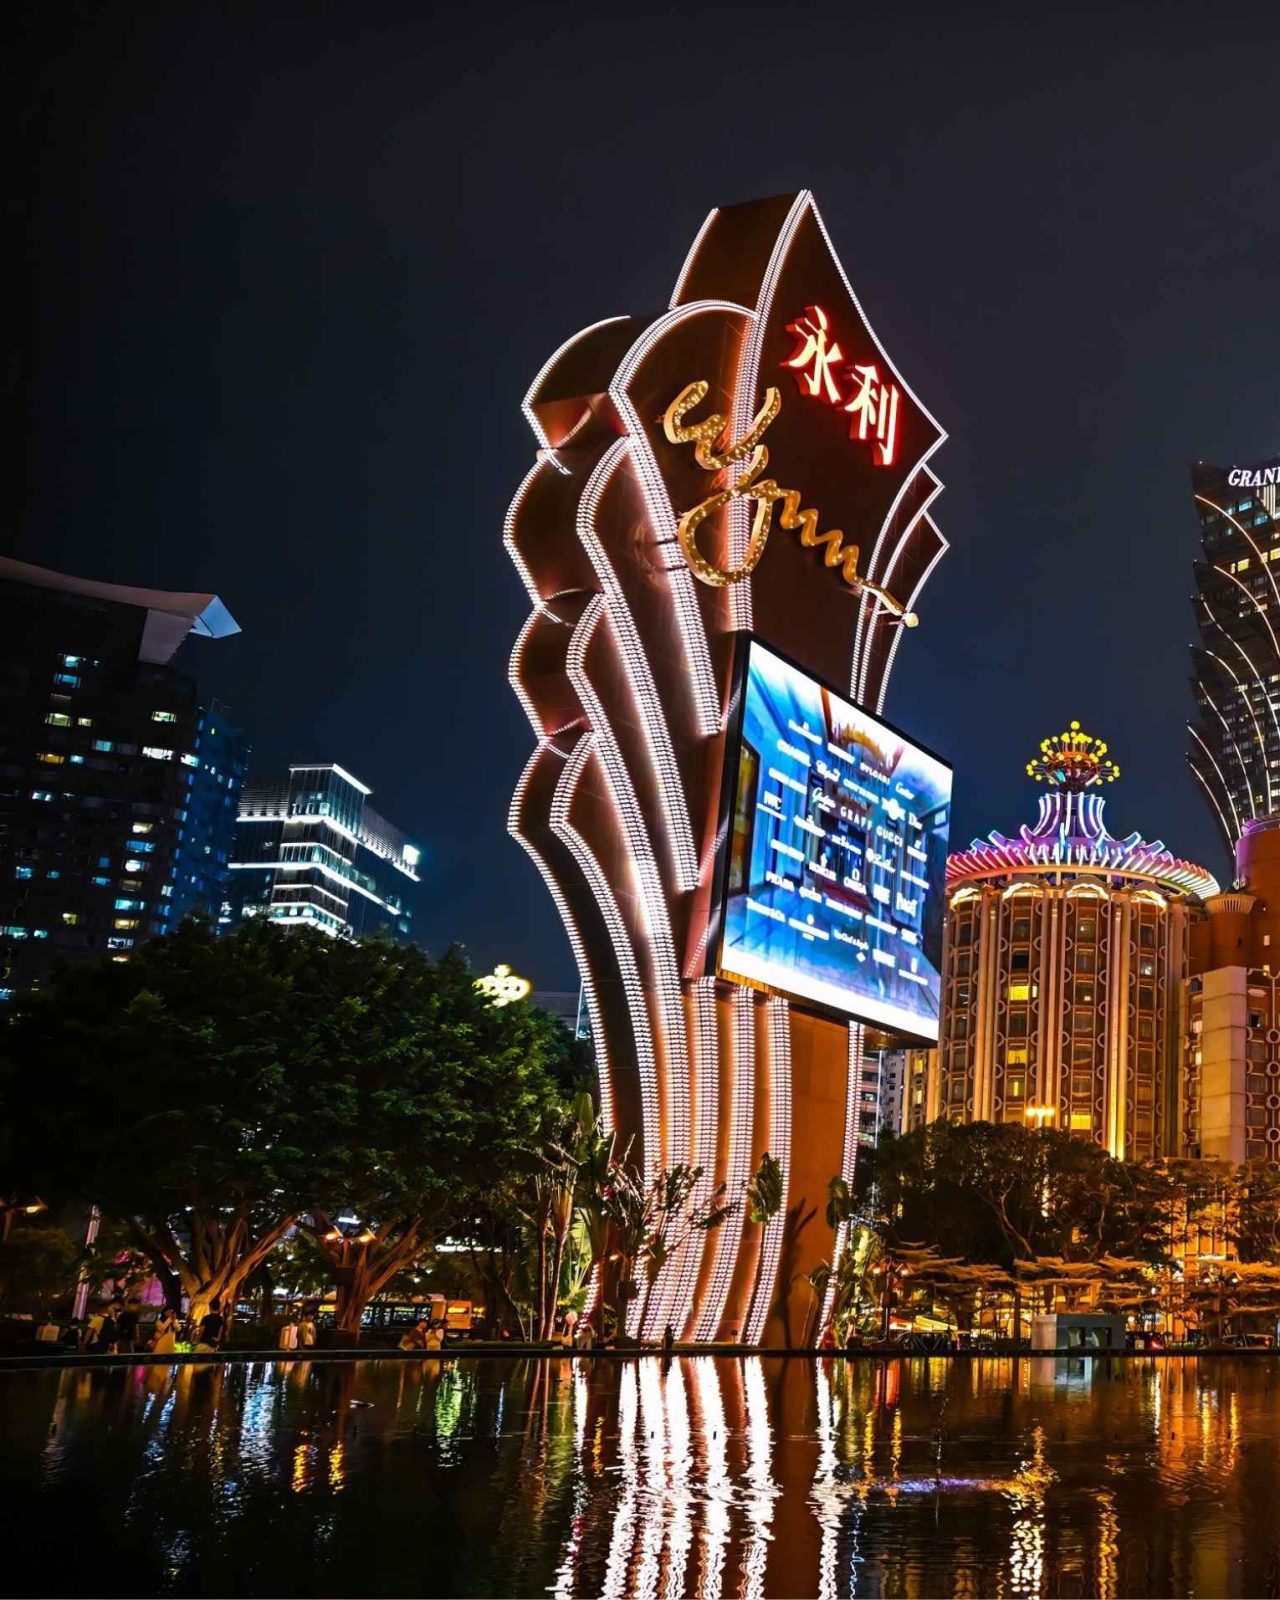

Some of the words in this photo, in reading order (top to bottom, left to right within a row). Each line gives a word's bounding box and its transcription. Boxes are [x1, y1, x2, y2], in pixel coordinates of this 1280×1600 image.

[783, 305, 899, 466] 永利
[662, 380, 920, 628] Wynn
[840, 806, 873, 831] GRAFF
[876, 825, 903, 848] GUCCI
